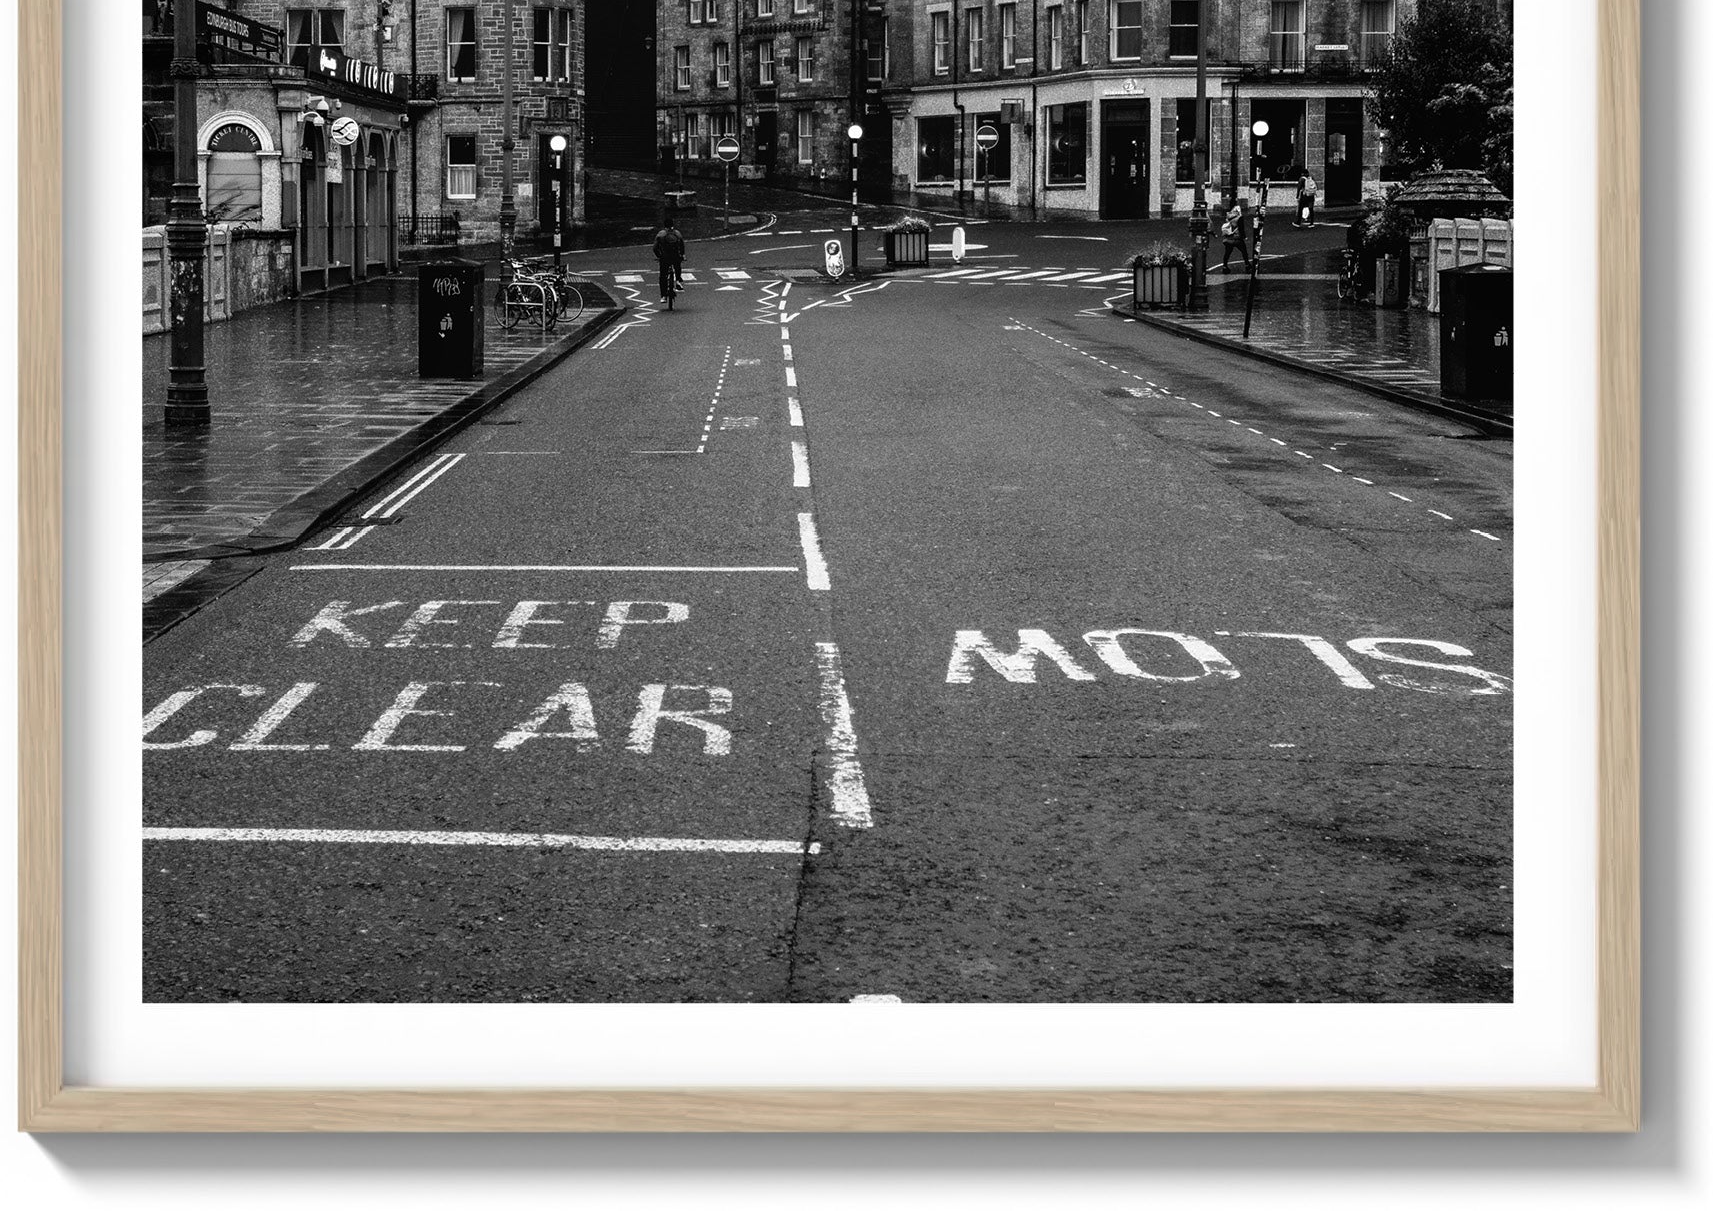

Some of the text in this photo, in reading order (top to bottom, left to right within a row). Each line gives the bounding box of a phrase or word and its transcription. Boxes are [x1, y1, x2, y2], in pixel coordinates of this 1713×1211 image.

[211, 126, 232, 146] TICKET
[286, 600, 691, 649] KEEP
[945, 628, 1514, 695] SLOW
[142, 682, 734, 756] CLEAR
